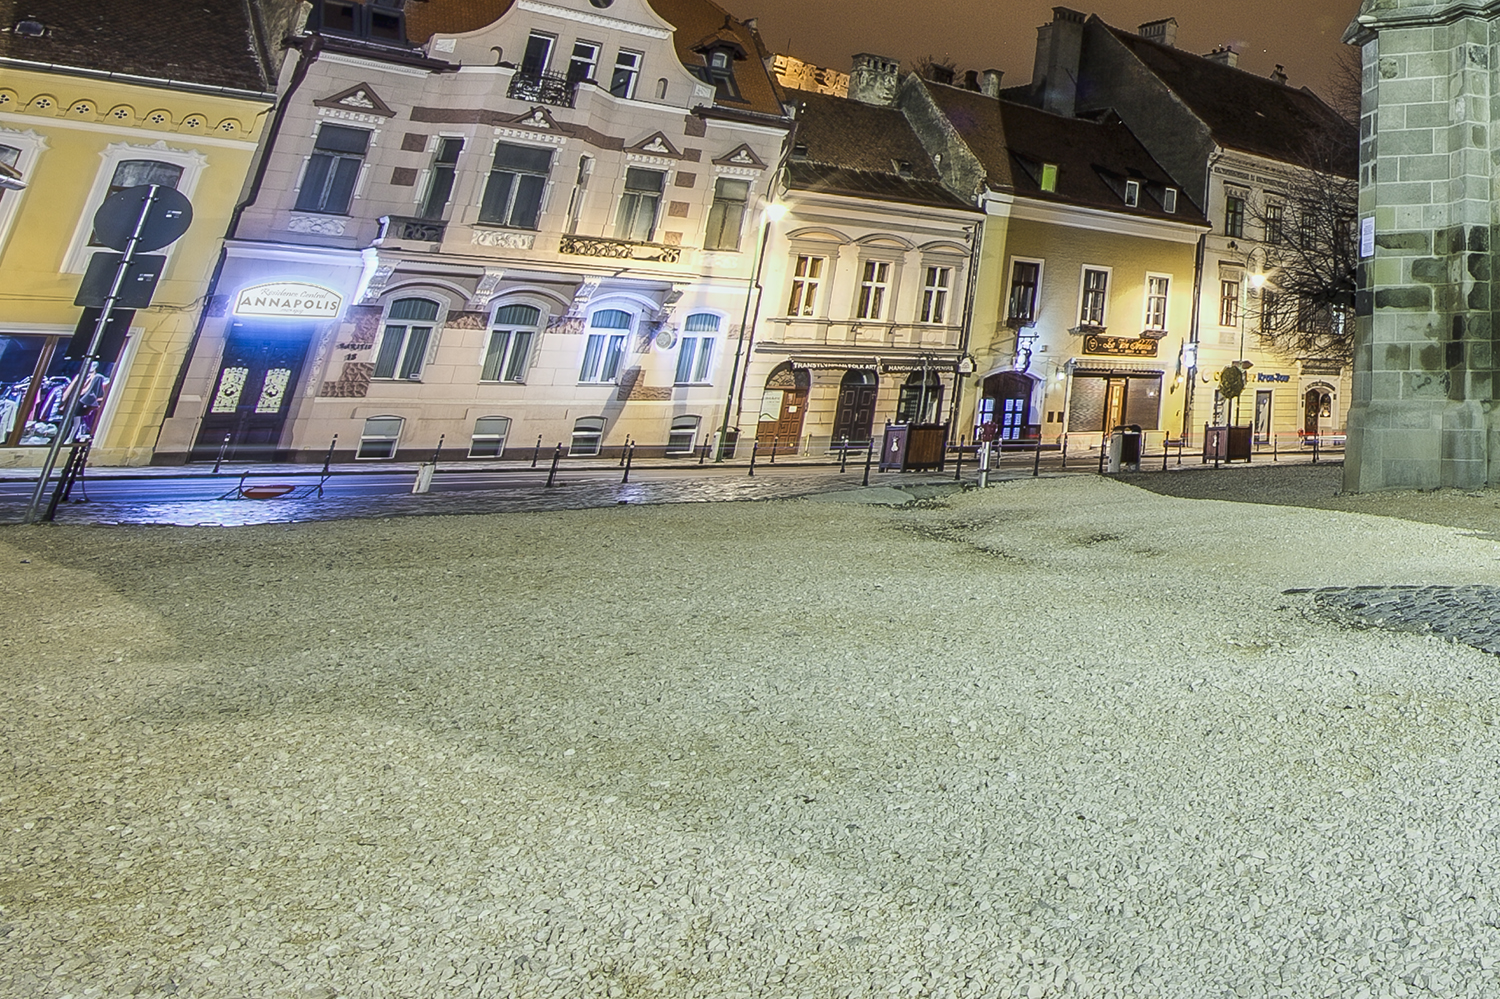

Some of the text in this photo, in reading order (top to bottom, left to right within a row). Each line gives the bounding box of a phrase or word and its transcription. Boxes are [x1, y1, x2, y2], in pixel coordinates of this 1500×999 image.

[261, 288, 328, 299] Residence Central
[240, 296, 337, 311] ANNAPOLIS
